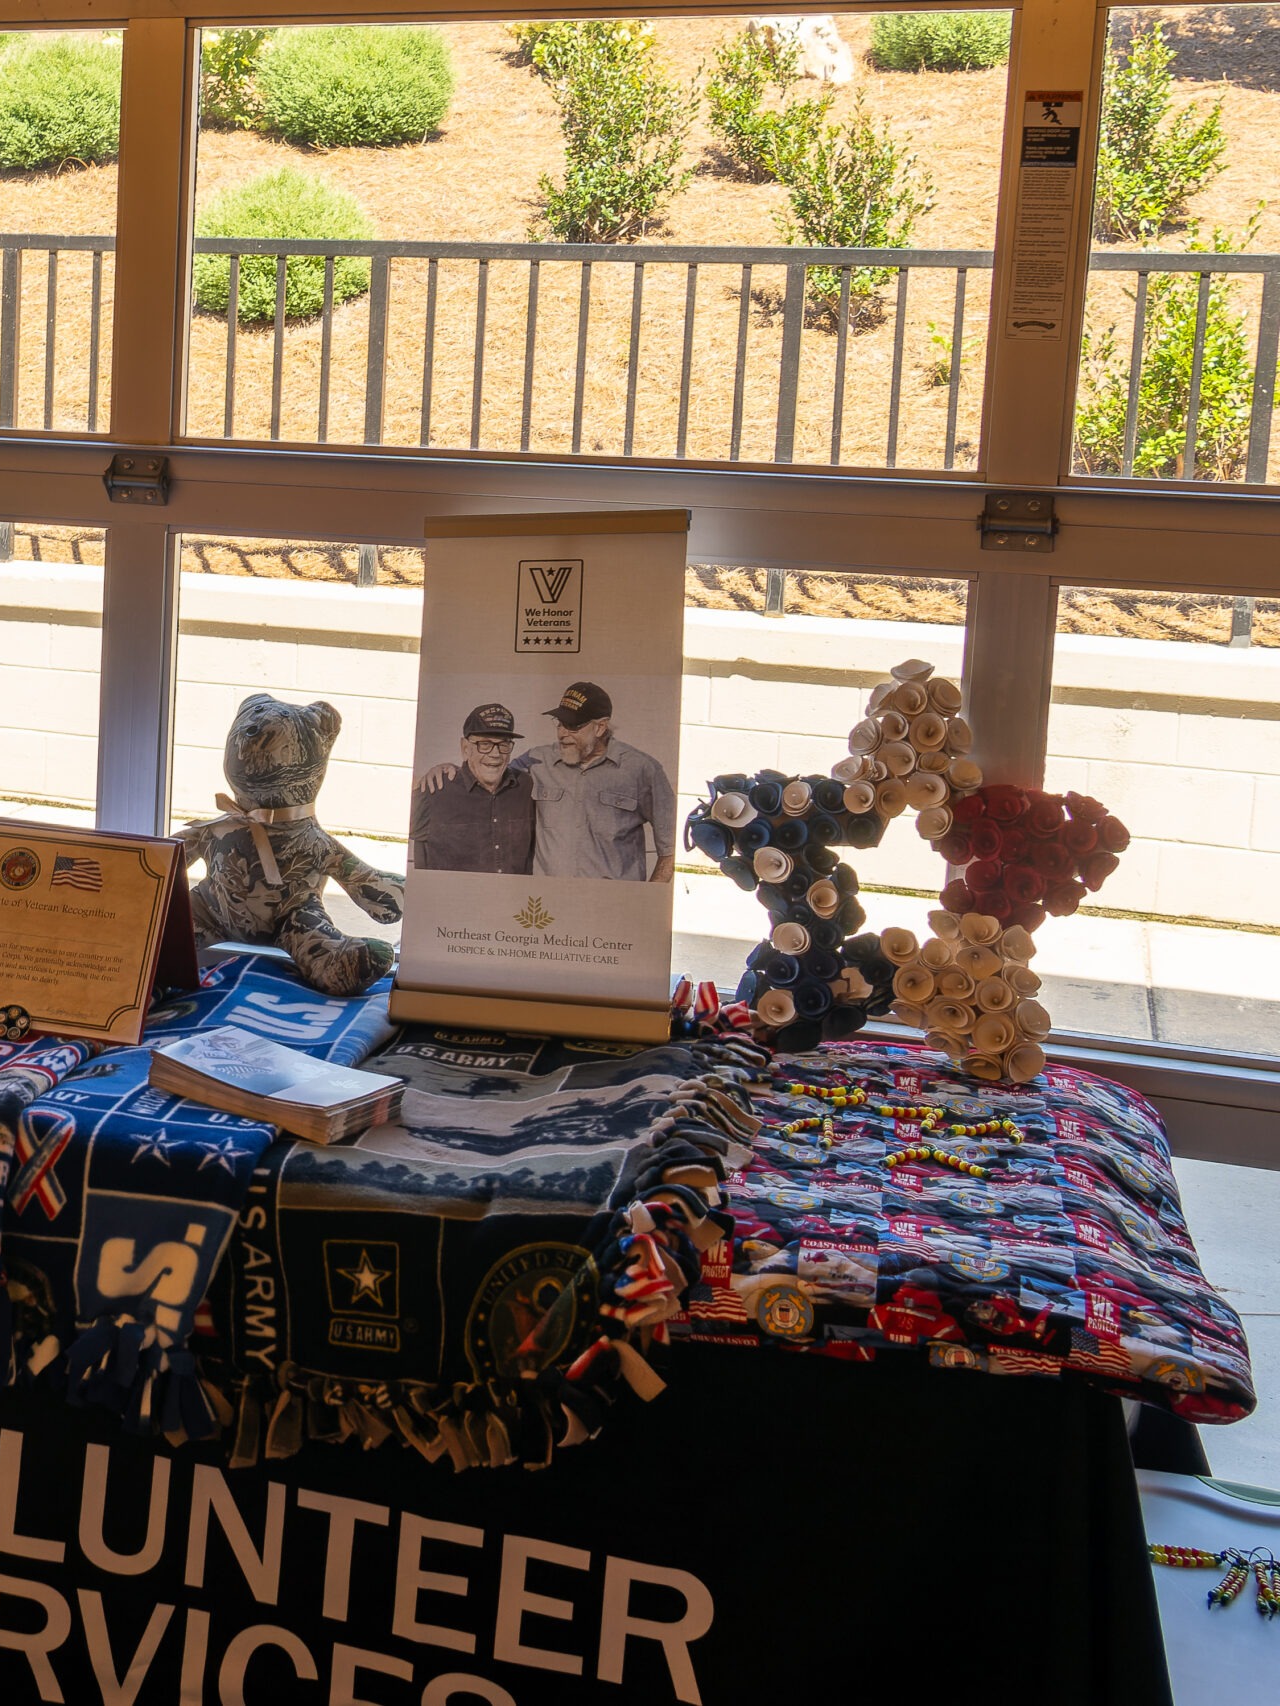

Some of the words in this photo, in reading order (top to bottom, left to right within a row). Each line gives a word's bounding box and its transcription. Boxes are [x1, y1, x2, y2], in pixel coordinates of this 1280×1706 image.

[543, 608, 574, 617] Honor
[526, 618, 571, 627] Veterans
[11, 897, 23, 908] of
[24, 900, 59, 913] Veteran
[61, 904, 117, 919] Recognition
[436, 926, 491, 941] Northeast
[494, 930, 539, 946] Georgia
[543, 934, 589, 948] Medical
[592, 936, 634, 952] Center
[447, 944, 486, 956] HOSPICE
[487, 947, 495, 956] &
[497, 948, 537, 959] IN-HOME
[539, 951, 591, 963] PALLIATIVE
[593, 954, 619, 965] CARE
[1060, 1118, 1081, 1133] WE
[701, 1264, 731, 1278] PROTECT
[1087, 1316, 1120, 1336] PROTECT
